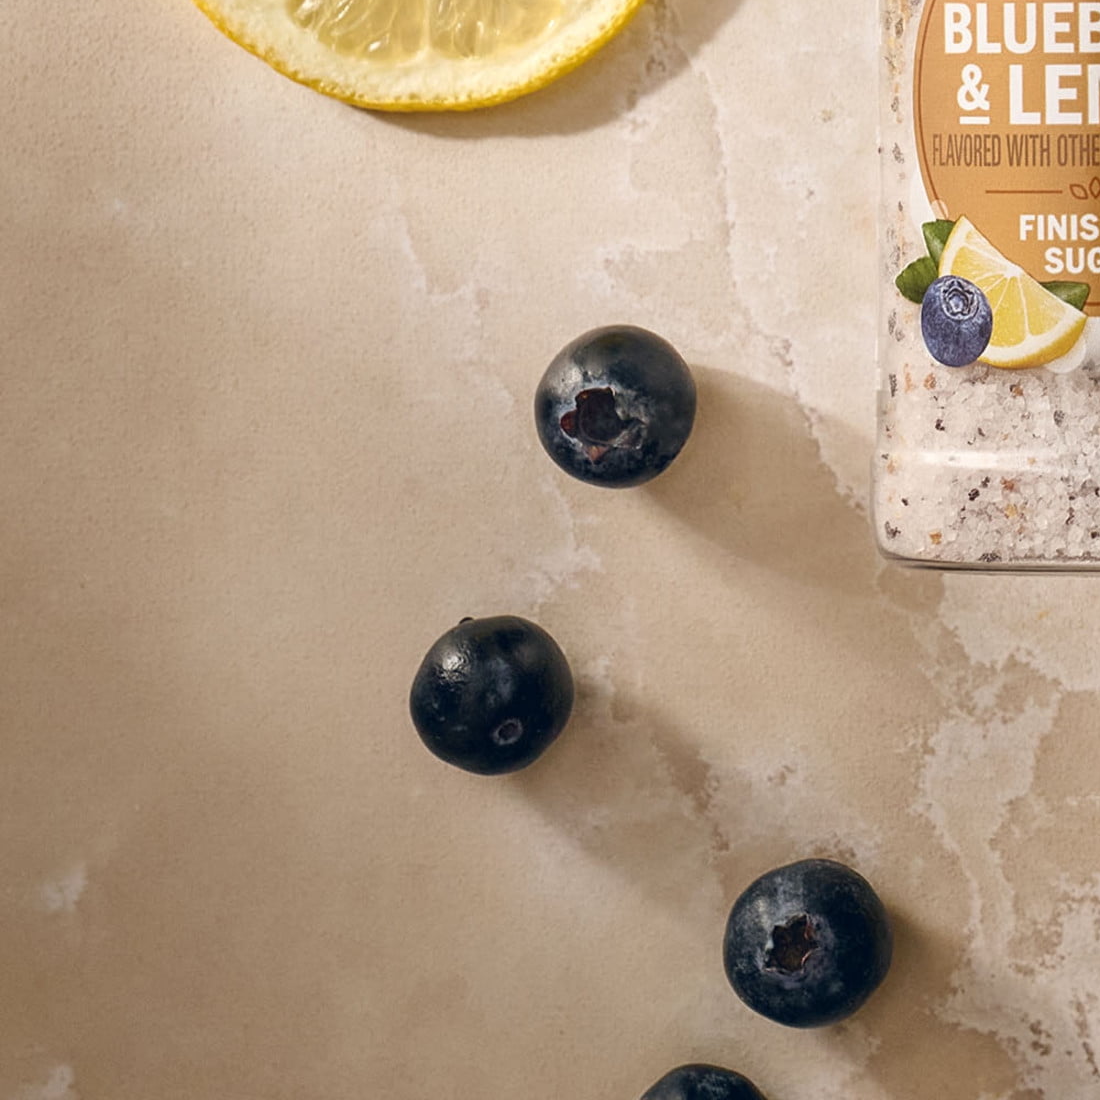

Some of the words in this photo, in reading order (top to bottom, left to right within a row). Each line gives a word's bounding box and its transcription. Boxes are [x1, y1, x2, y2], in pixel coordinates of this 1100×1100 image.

[957, 63, 991, 125] &
[932, 132, 1002, 167] FLAVORED
[1005, 133, 1052, 167] WITH
